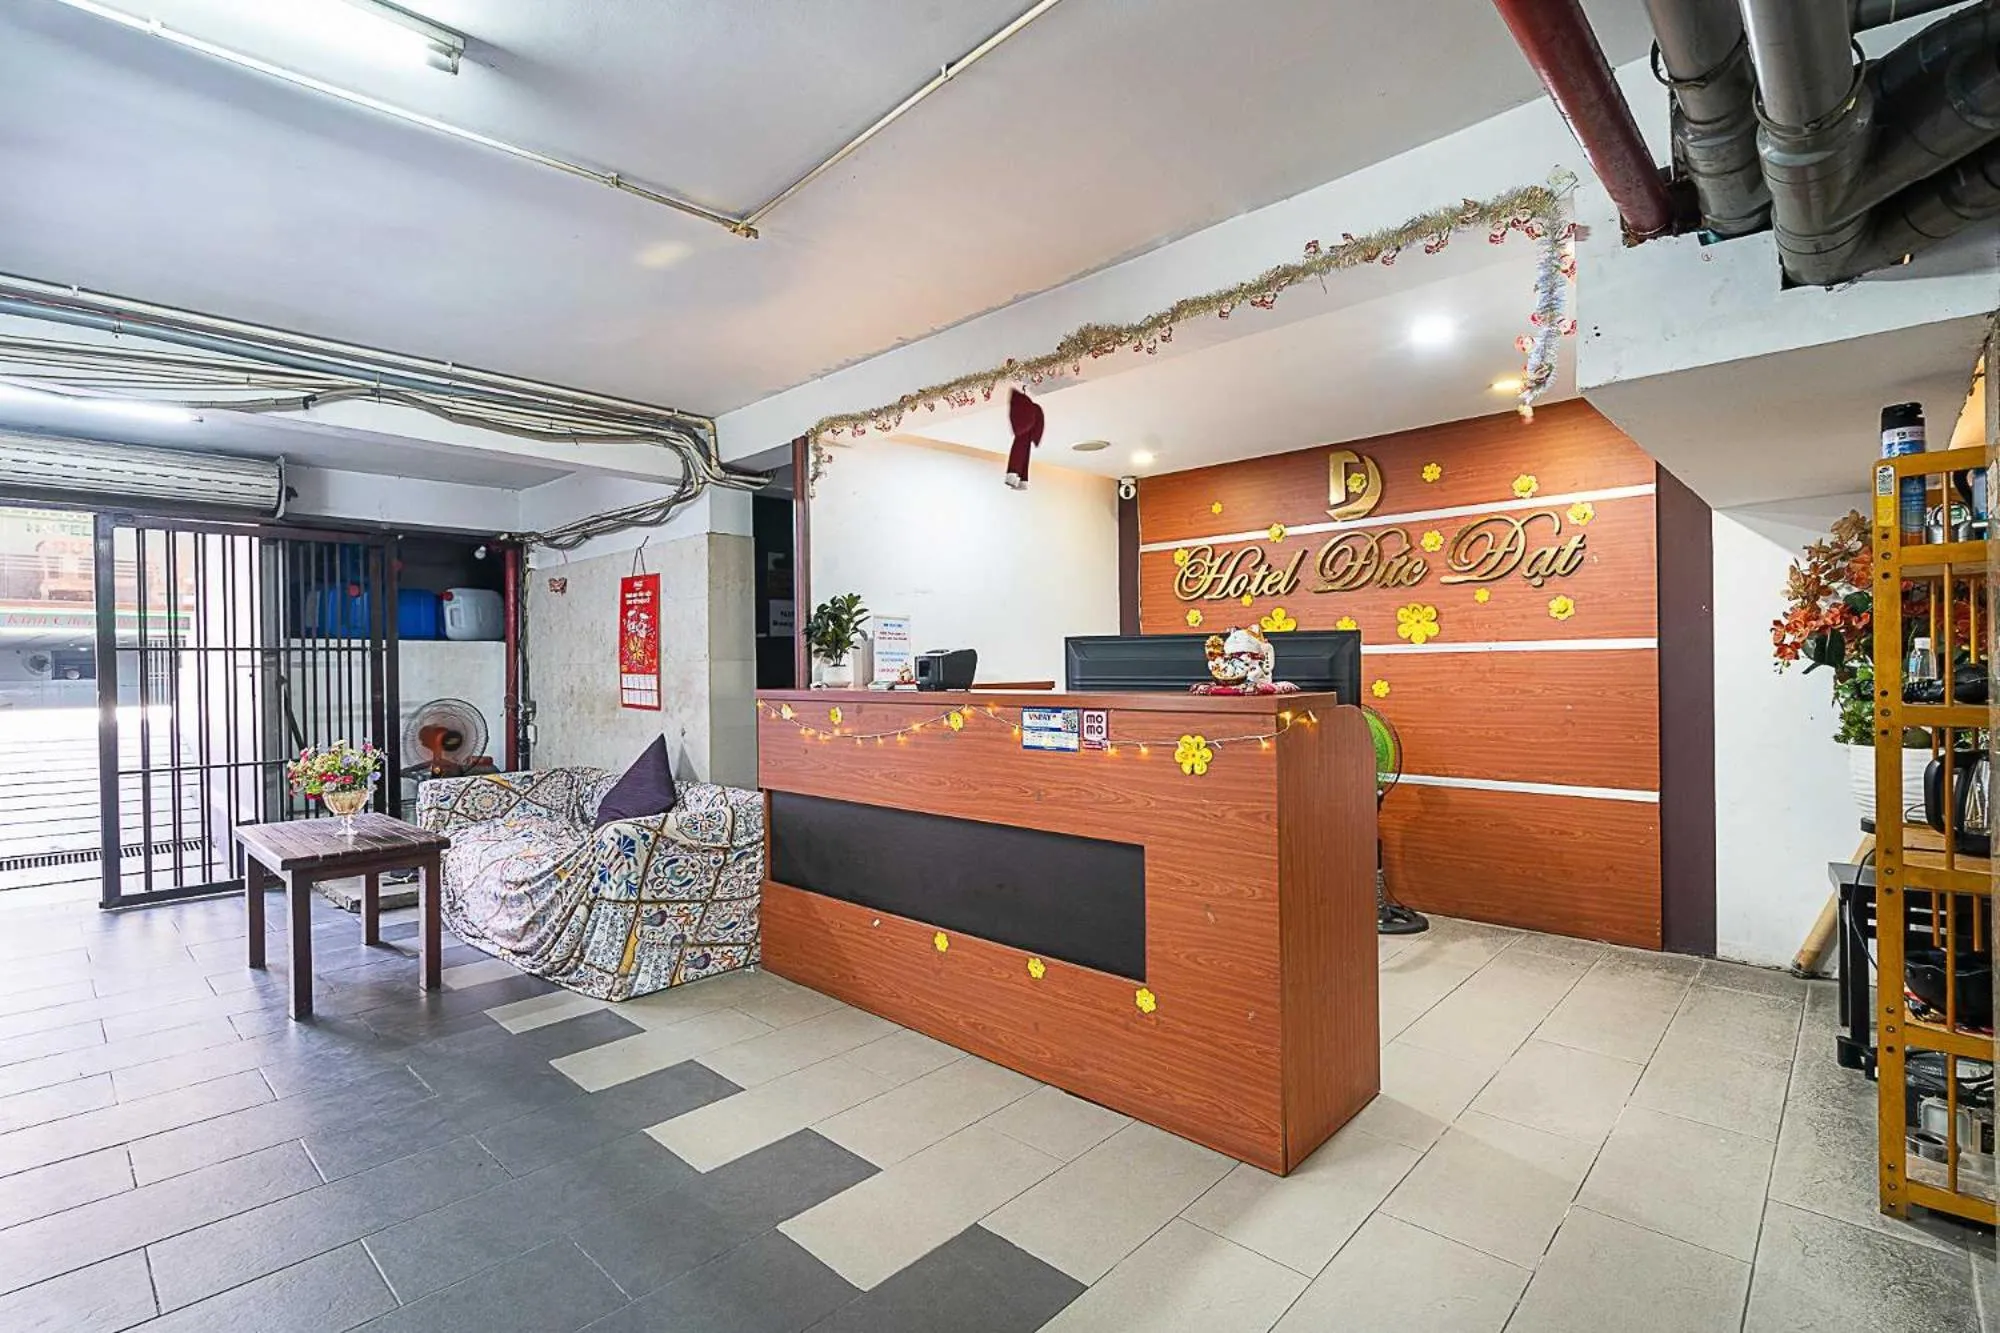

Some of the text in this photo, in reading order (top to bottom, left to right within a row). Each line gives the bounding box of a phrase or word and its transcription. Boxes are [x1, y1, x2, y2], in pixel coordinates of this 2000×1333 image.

[1174, 511, 1586, 601] Hotel Đức Đạt
